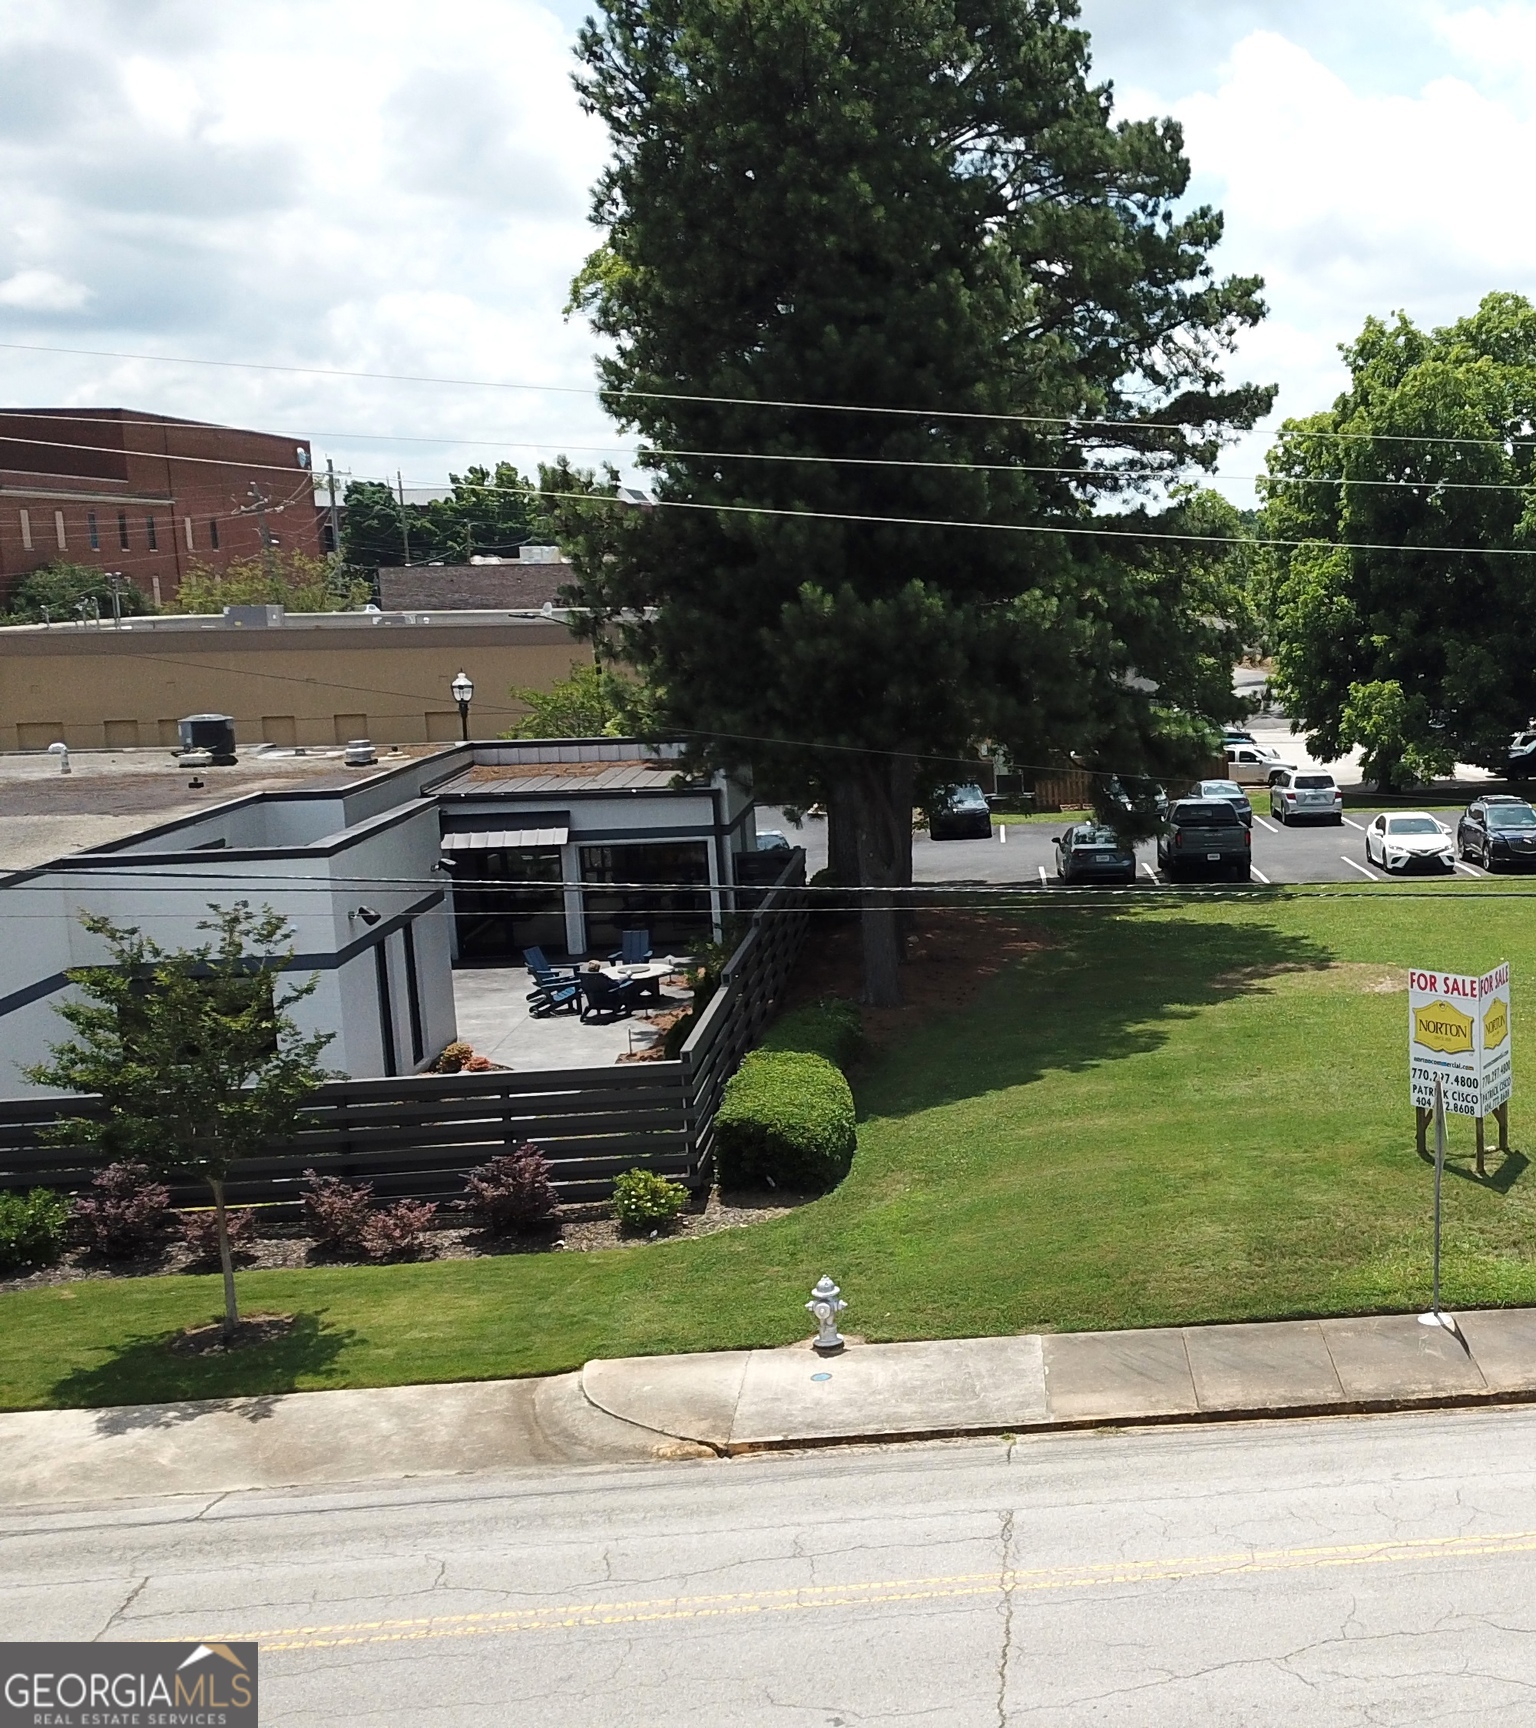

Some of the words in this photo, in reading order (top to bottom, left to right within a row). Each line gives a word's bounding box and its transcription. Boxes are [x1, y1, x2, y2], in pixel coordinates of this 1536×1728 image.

[1410, 972, 1438, 993] FOR
[1443, 976, 1477, 998] SALE
[1480, 974, 1494, 998] FOR
[1494, 965, 1509, 989] SALE
[1418, 1019, 1467, 1038] NORTON
[1451, 1091, 1479, 1104] CISCO
